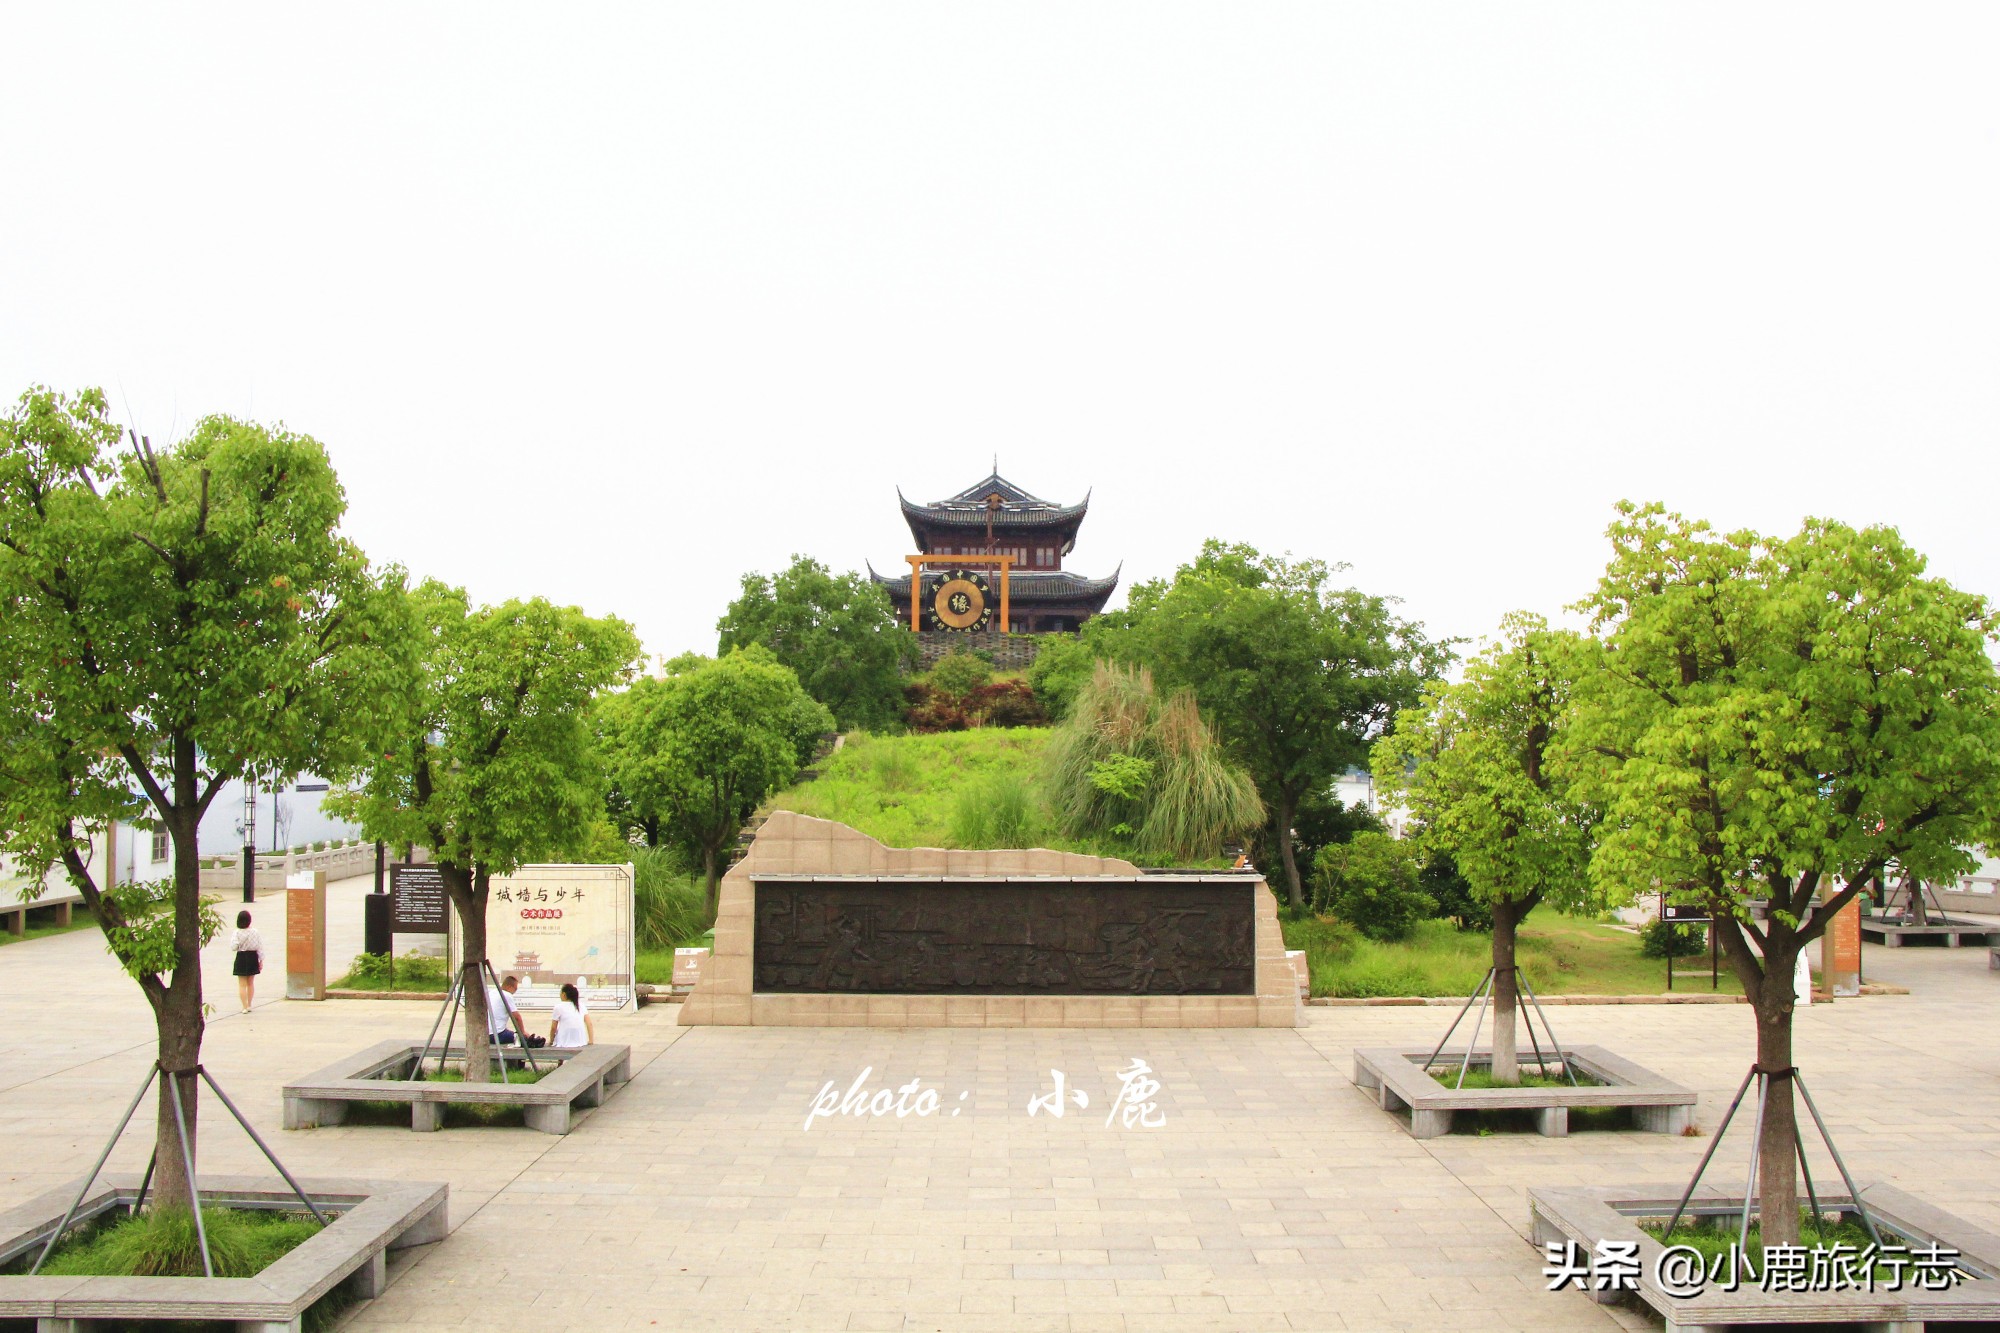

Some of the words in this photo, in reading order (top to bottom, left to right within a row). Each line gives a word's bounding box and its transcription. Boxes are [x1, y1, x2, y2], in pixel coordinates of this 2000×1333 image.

[496, 886, 585, 903] 城墙与少年
[521, 909, 562, 919] 艺术作品展
